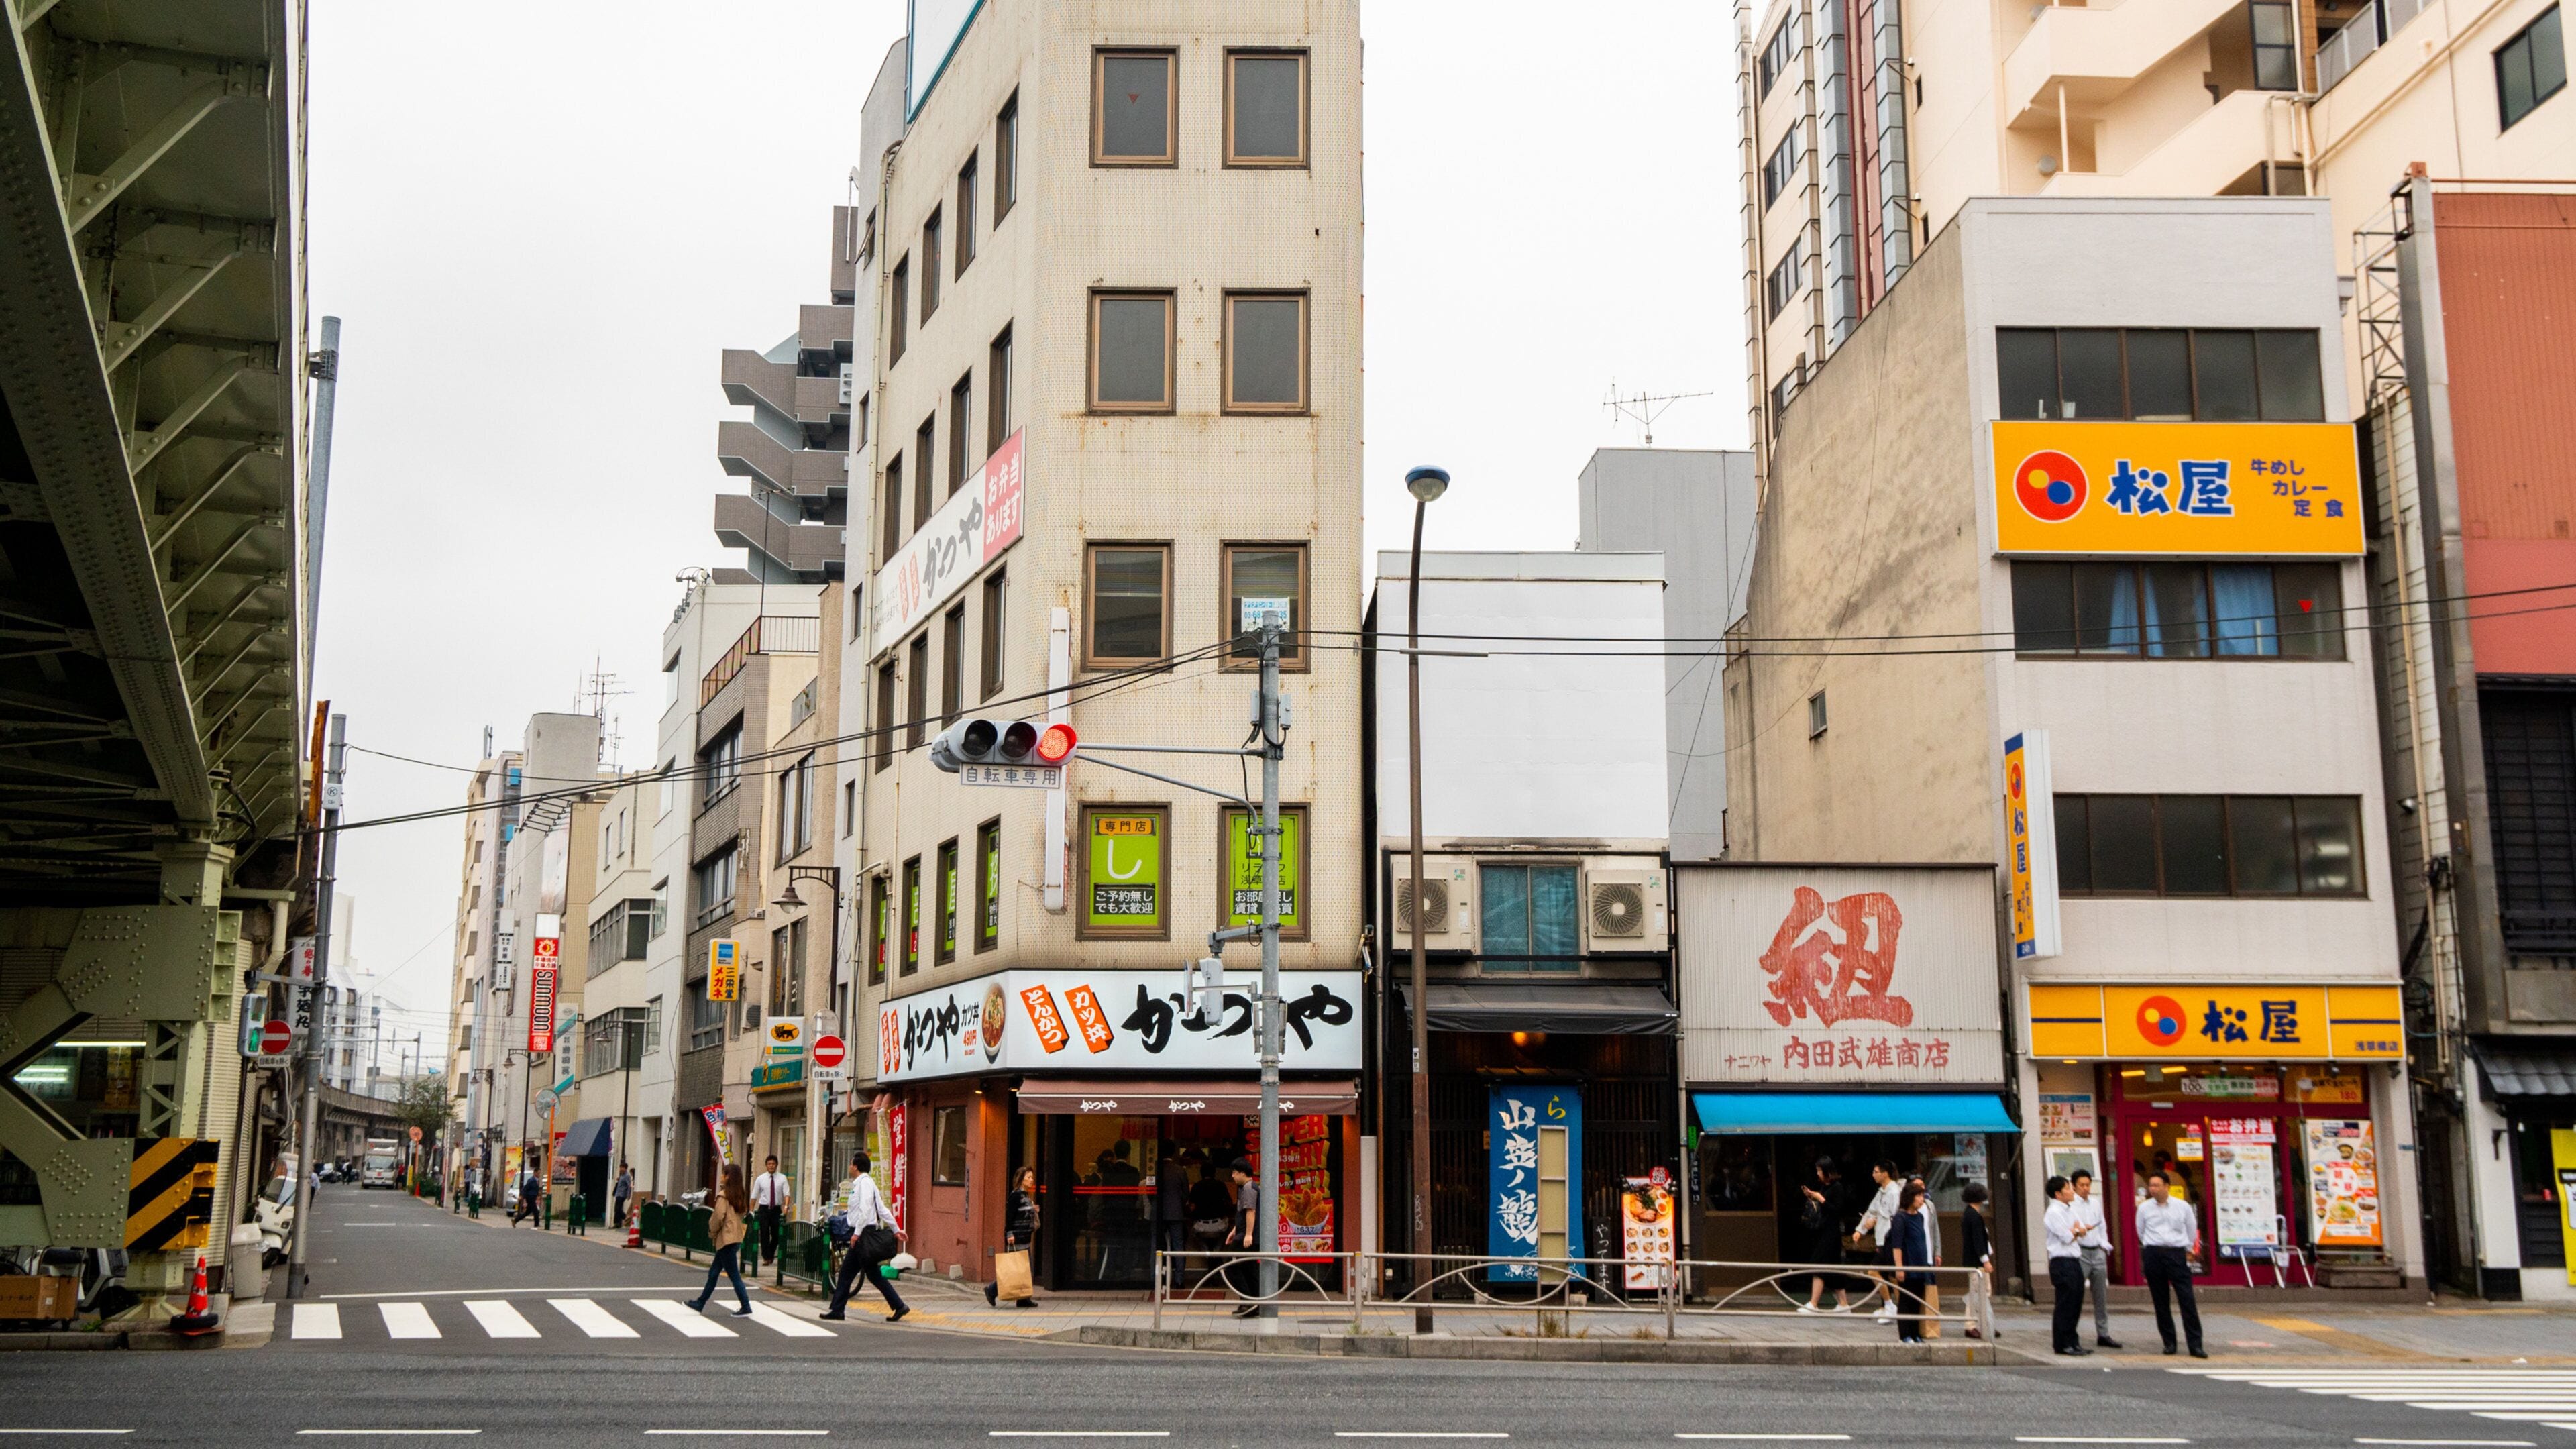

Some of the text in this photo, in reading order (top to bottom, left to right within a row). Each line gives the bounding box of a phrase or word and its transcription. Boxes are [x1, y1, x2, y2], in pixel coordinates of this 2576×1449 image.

[988, 452, 1020, 508] お弁当
[2251, 459, 2305, 476] 牛めし
[2106, 460, 2233, 515] 松屋
[2272, 480, 2328, 496] カレー
[986, 493, 1020, 545] あります
[2294, 499, 2344, 517] 定食
[923, 497, 983, 599] かつや
[967, 767, 1056, 785] 自転車専用
[1105, 821, 1146, 832] 専門店
[1241, 875, 1286, 885] 浅草店
[1242, 863, 1286, 873] リラフ
[1095, 903, 1154, 914] でも大歓迎
[1096, 891, 1153, 902] ご予約無し
[1235, 891, 1293, 902] お部し
[713, 967, 724, 999] メガネ
[961, 1002, 979, 1027] カツ丼
[1025, 989, 1063, 1044] とんかつ
[1073, 989, 1108, 1044] カツ丼
[1120, 983, 1354, 1054] かつや
[2200, 1000, 2301, 1043] 松屋
[904, 994, 959, 1071] かつや
[1724, 1035, 1950, 1071] ナニワヤ 内田武雄商店
[1080, 1099, 1118, 1112] かつや
[1169, 1099, 1205, 1112] かつや
[1246, 1114, 1329, 1152] SPER
[892, 1113, 906, 1218] 営業中
[1245, 1140, 1330, 1175] HGRY
